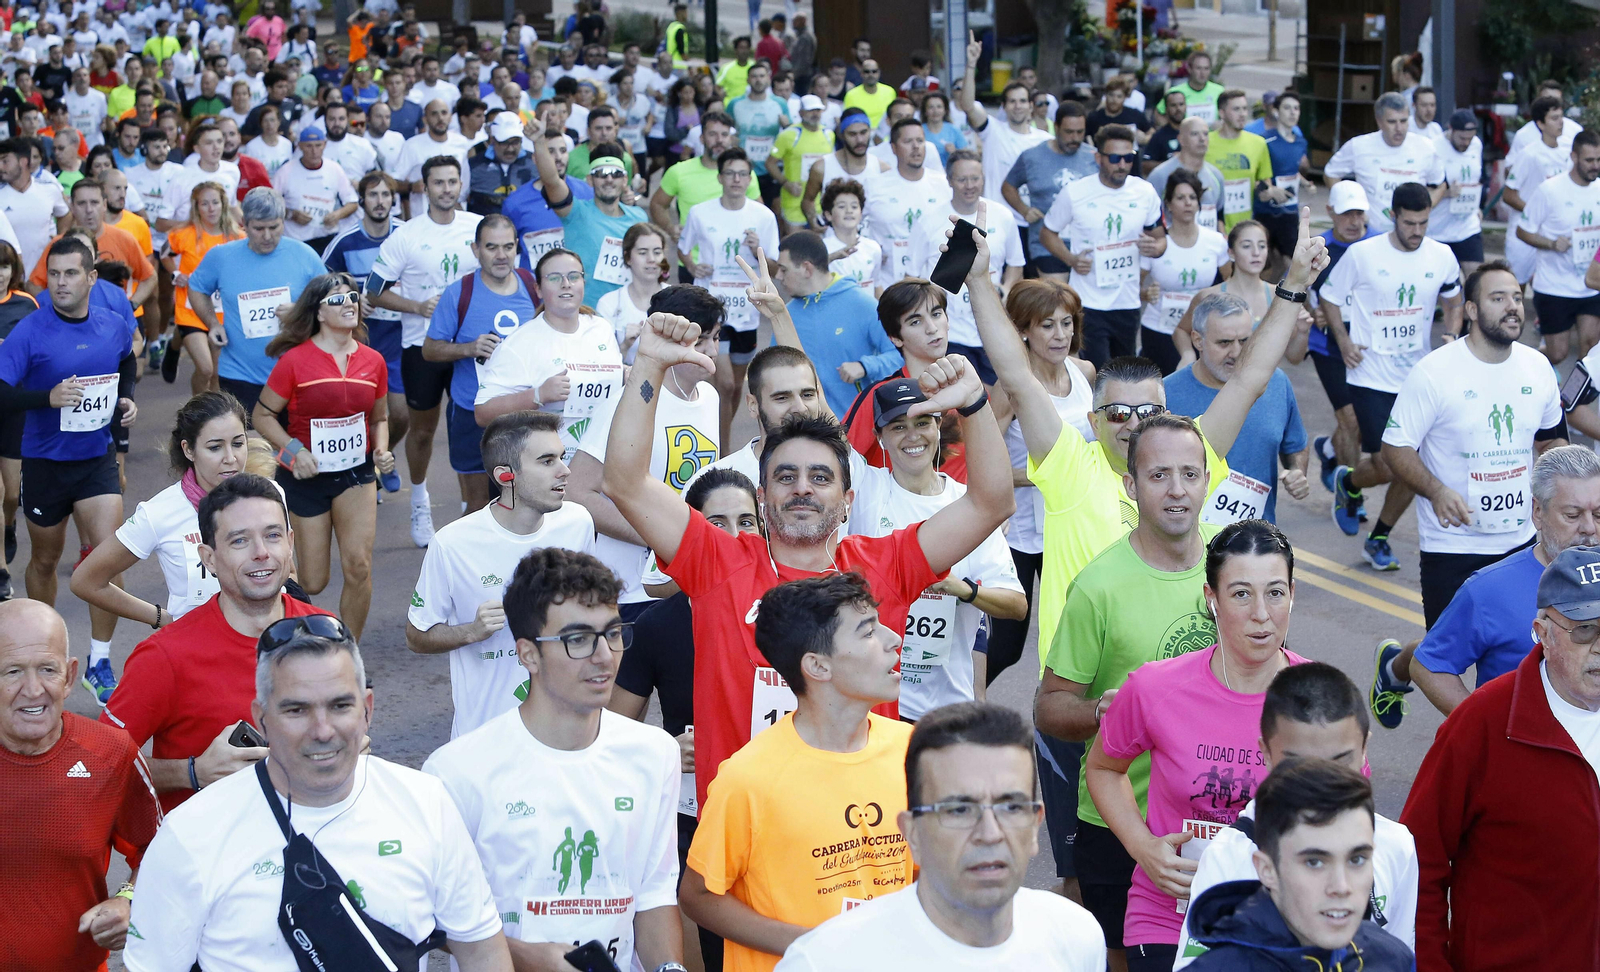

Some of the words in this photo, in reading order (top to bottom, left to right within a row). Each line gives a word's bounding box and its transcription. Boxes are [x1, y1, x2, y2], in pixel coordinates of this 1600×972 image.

[1104, 255, 1133, 270] 1223
[249, 307, 276, 322] 225
[1382, 324, 1416, 338] 1198
[576, 382, 612, 399] 1801
[72, 394, 109, 413] 2641
[317, 433, 363, 454] 18013
[1214, 494, 1257, 520] 9478
[1480, 490, 1524, 512] 9204
[185, 532, 201, 544] 41
[905, 614, 947, 639] 262
[1196, 744, 1235, 763] CIUDAD
[1238, 748, 1253, 765] DE
[66, 770, 92, 778] adidas
[506, 803, 536, 816] 2020
[811, 838, 861, 858] CARRERA
[822, 855, 838, 871] del
[527, 901, 549, 916] 41
[550, 899, 602, 908] CARRERA
